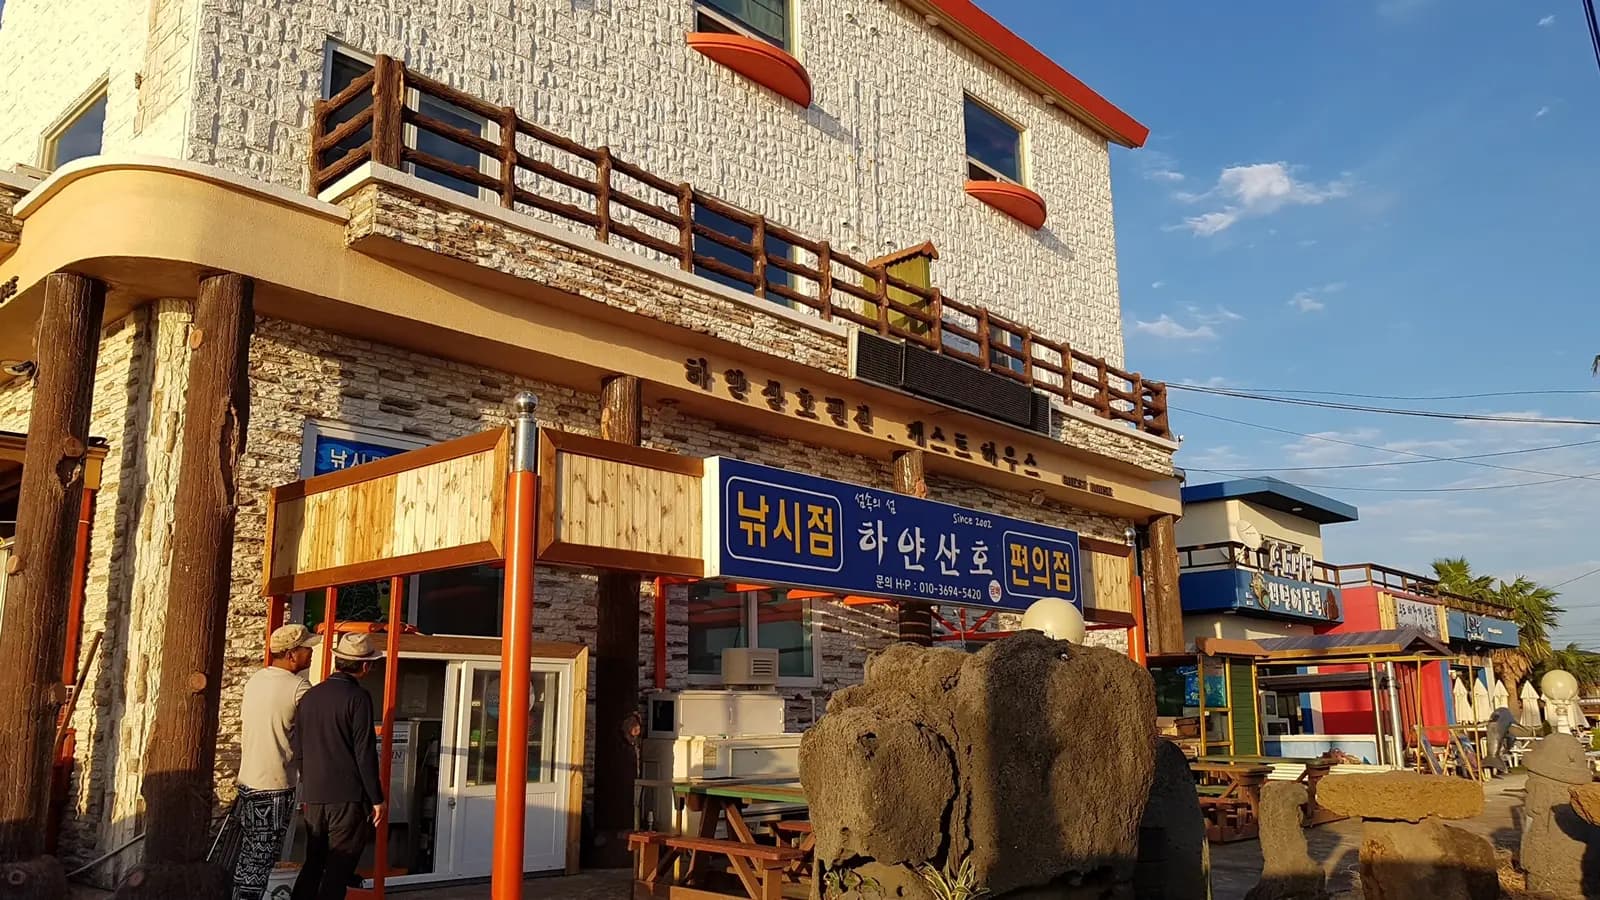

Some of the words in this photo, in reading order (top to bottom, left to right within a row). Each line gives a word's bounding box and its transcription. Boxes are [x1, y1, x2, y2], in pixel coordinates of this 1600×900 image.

[683, 357, 873, 434] 하얀산호펜션
[737, 491, 834, 558] 낚시점
[854, 492, 881, 512] 섬속의
[885, 499, 897, 515] 섬
[952, 512, 973, 526] Since
[975, 517, 993, 529] 2002
[857, 519, 993, 577] 하얀산호
[1009, 543, 1071, 593] 편의점
[875, 575, 893, 589] 문의
[919, 581, 982, 601] 010-3694-5420
